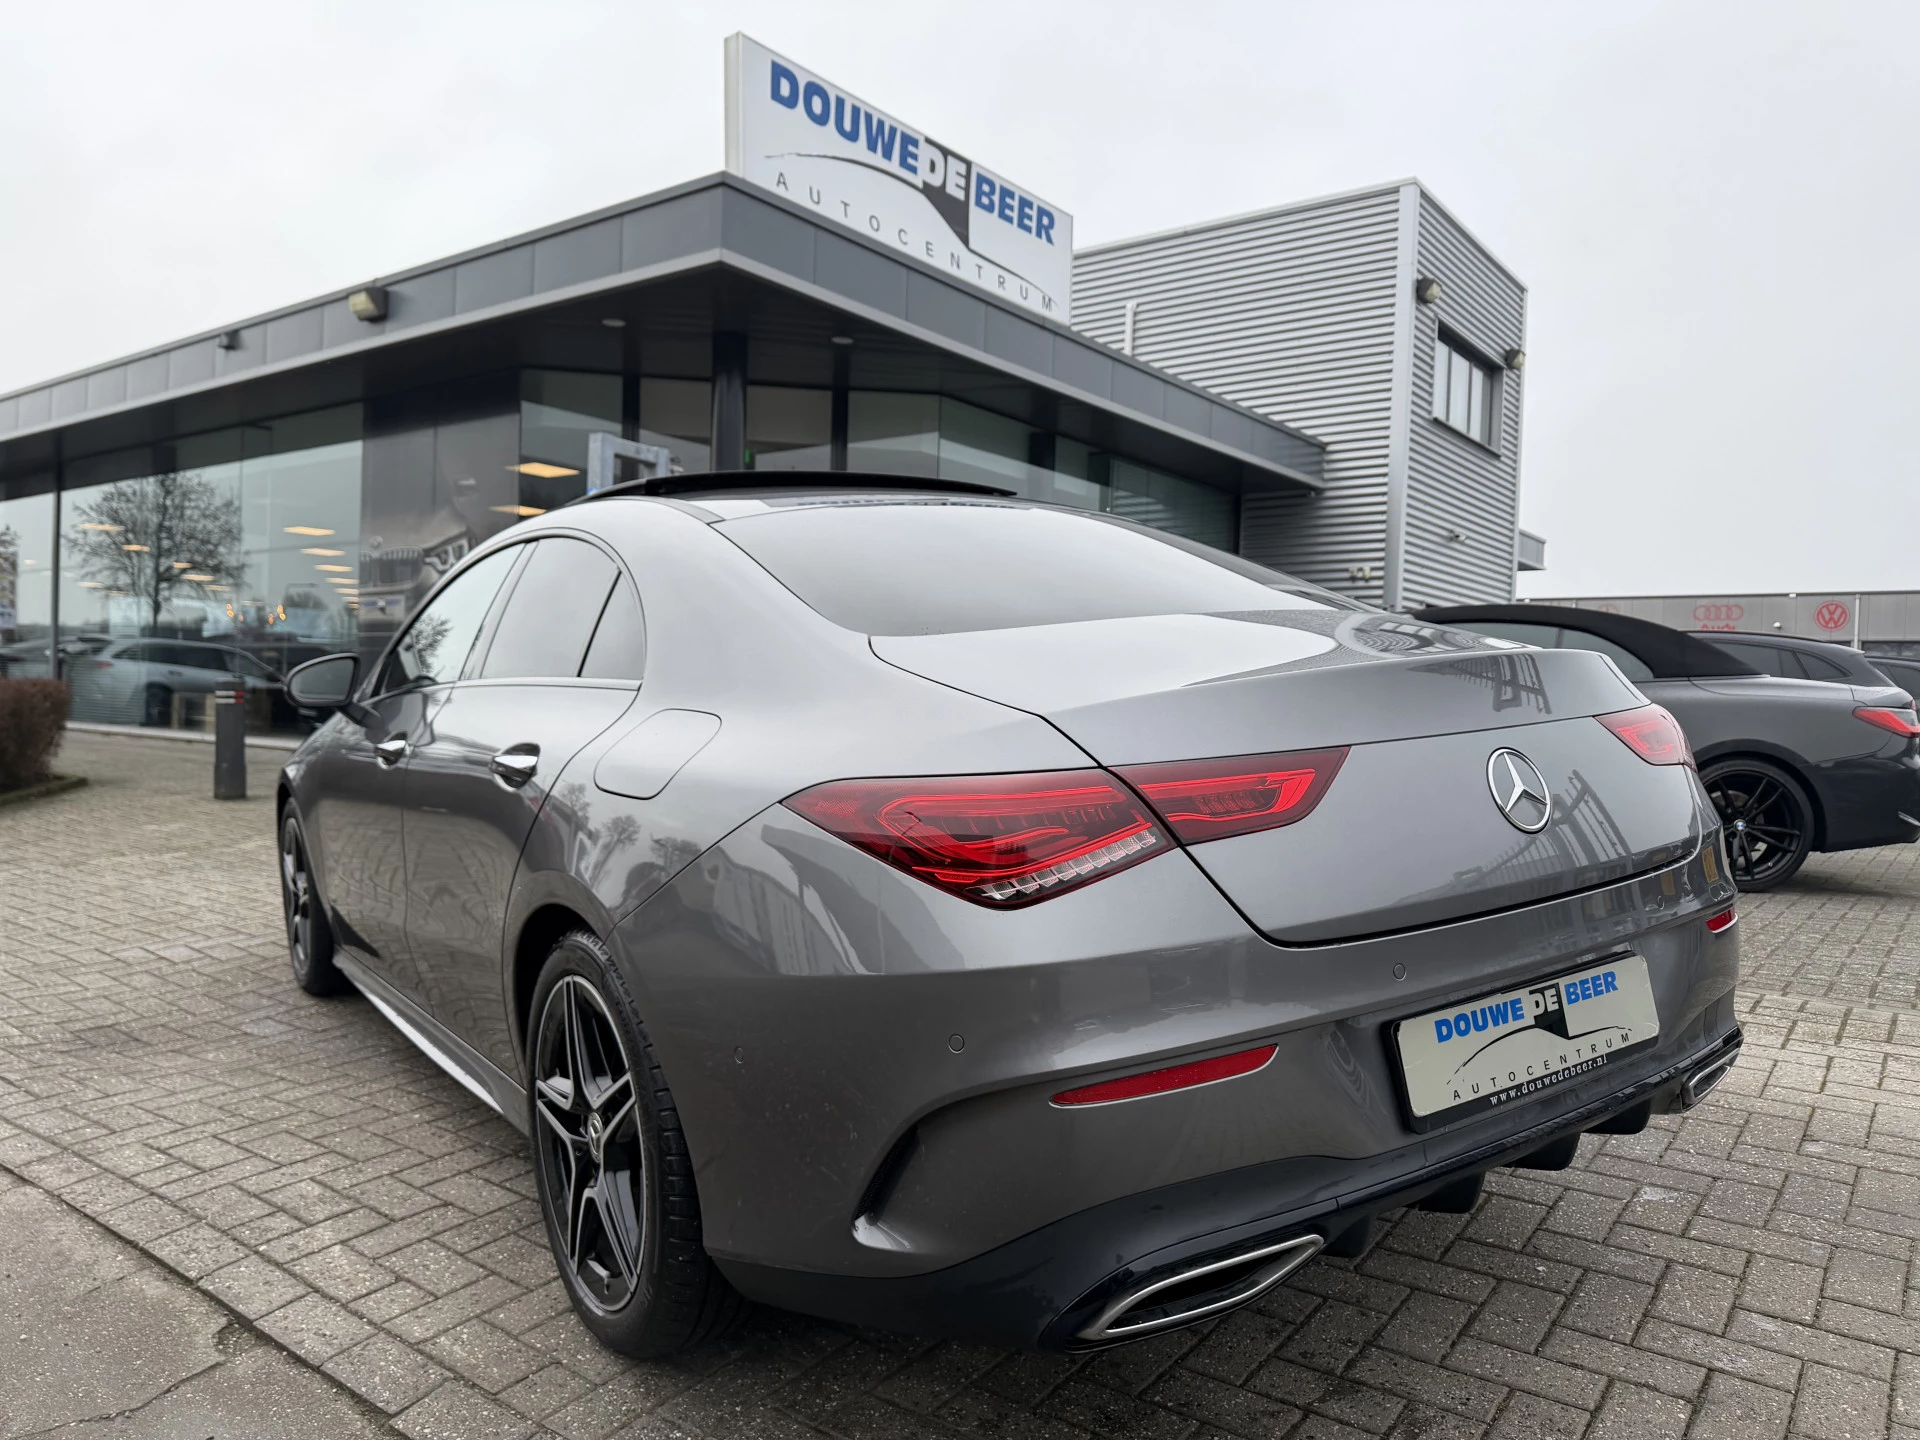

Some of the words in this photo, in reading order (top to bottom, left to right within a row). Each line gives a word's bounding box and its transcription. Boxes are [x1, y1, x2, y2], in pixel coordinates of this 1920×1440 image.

[770, 59, 919, 175] DOUWE
[920, 138, 967, 202] DE
[974, 172, 1055, 246] BEER
[776, 172, 1053, 312] AUTOCENTRUM
[1434, 998, 1525, 1043] DOUWE
[1533, 988, 1560, 1017] DE
[1564, 970, 1619, 1006] BEER
[1453, 1033, 1630, 1101] AUTOCENTRUM
[1490, 1053, 1608, 1106] www.douwedebeer.nl
